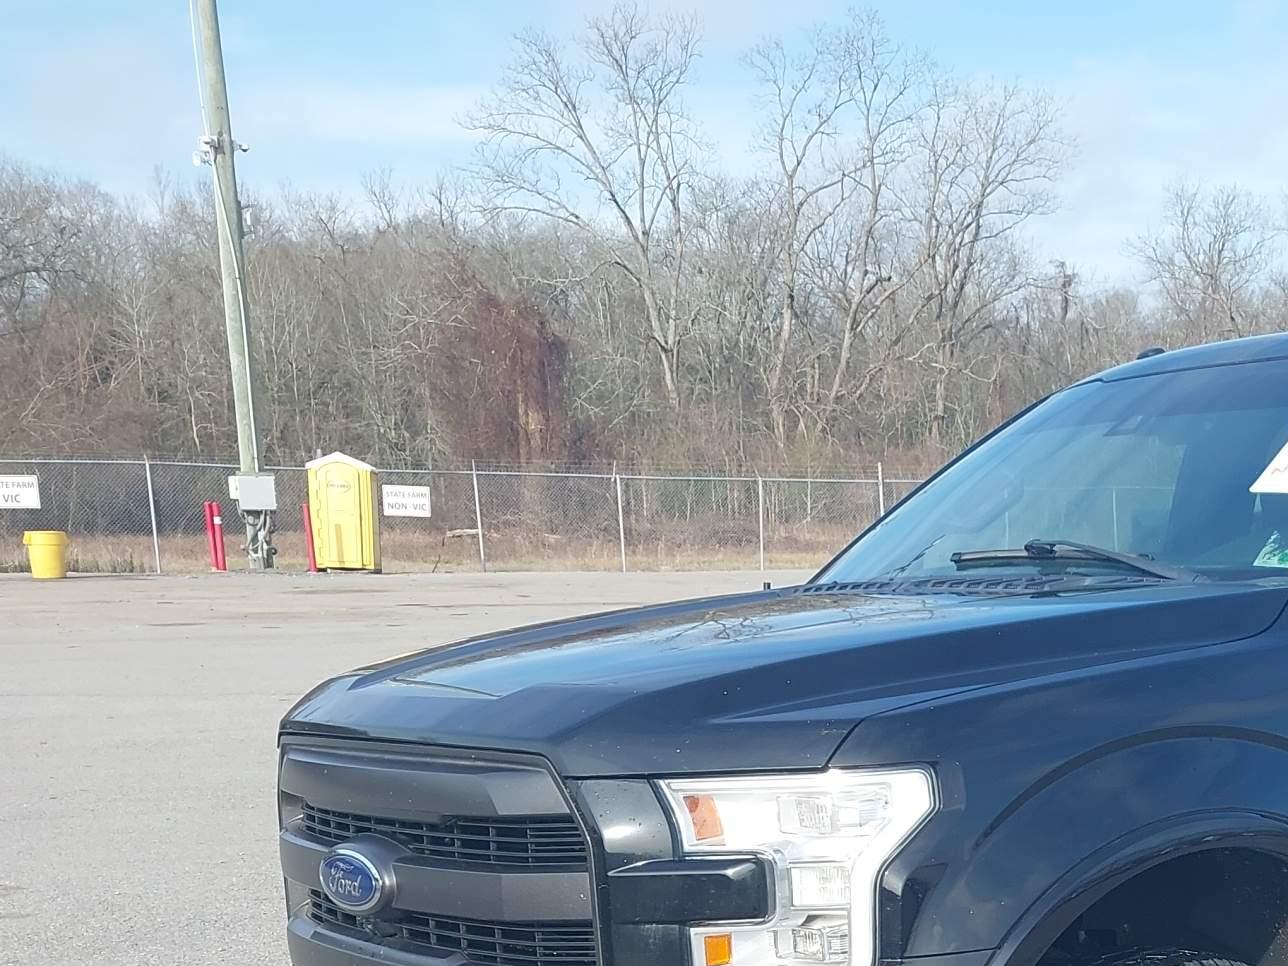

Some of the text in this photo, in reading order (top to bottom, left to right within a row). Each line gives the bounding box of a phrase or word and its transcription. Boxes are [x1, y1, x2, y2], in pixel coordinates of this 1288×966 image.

[11, 481, 35, 489] FARM
[2, 494, 21, 503] VIC
[328, 862, 363, 896] Ford
